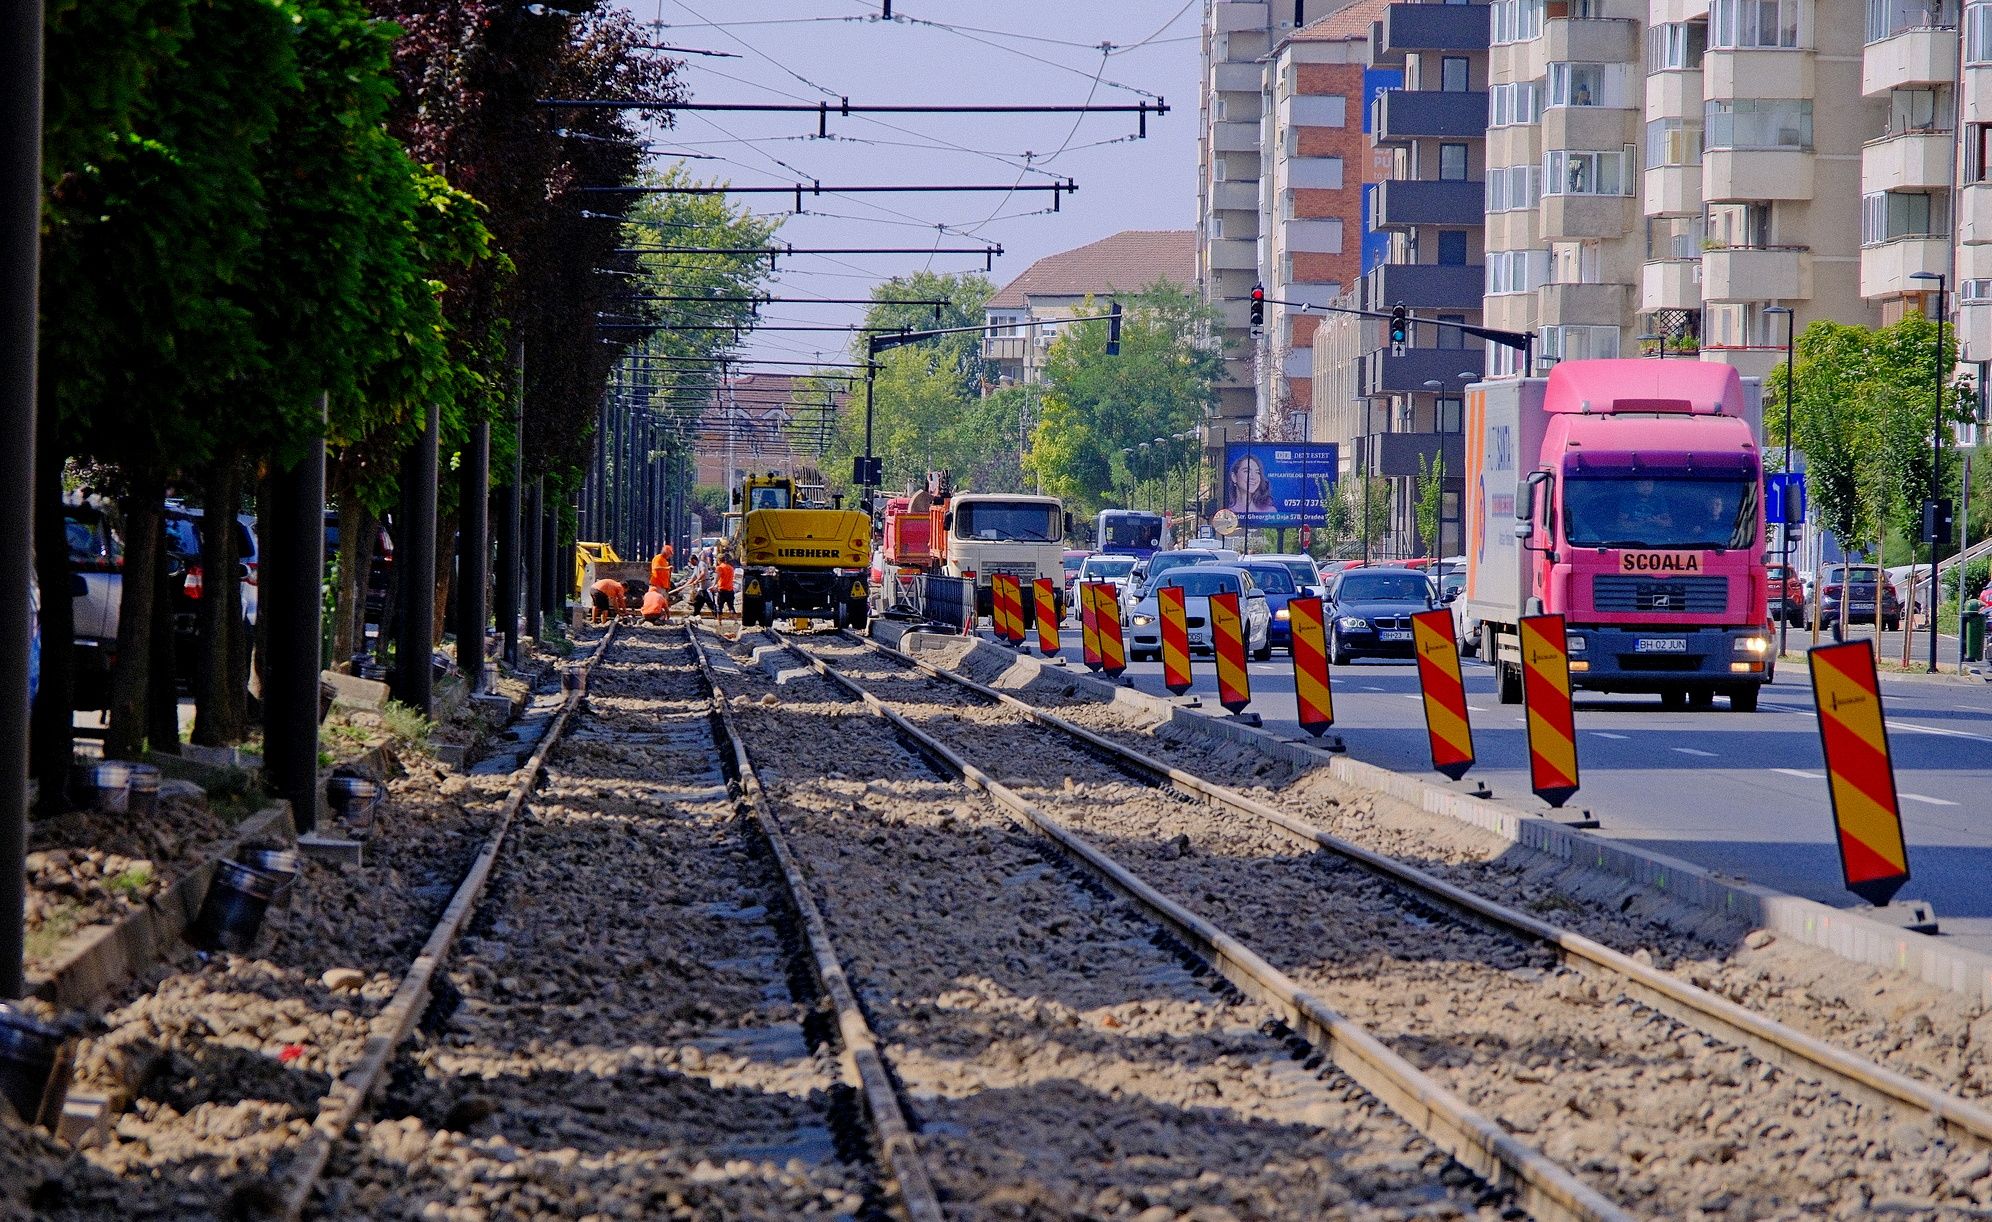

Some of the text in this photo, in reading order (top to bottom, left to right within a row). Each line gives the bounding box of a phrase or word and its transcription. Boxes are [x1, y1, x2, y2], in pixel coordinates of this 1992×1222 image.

[1284, 499, 1300, 507] 0757
[778, 548, 840, 558] LIEBHERR
[1623, 553, 1698, 571] SCOALA
[1640, 640, 1685, 649] BH 02 JUN
